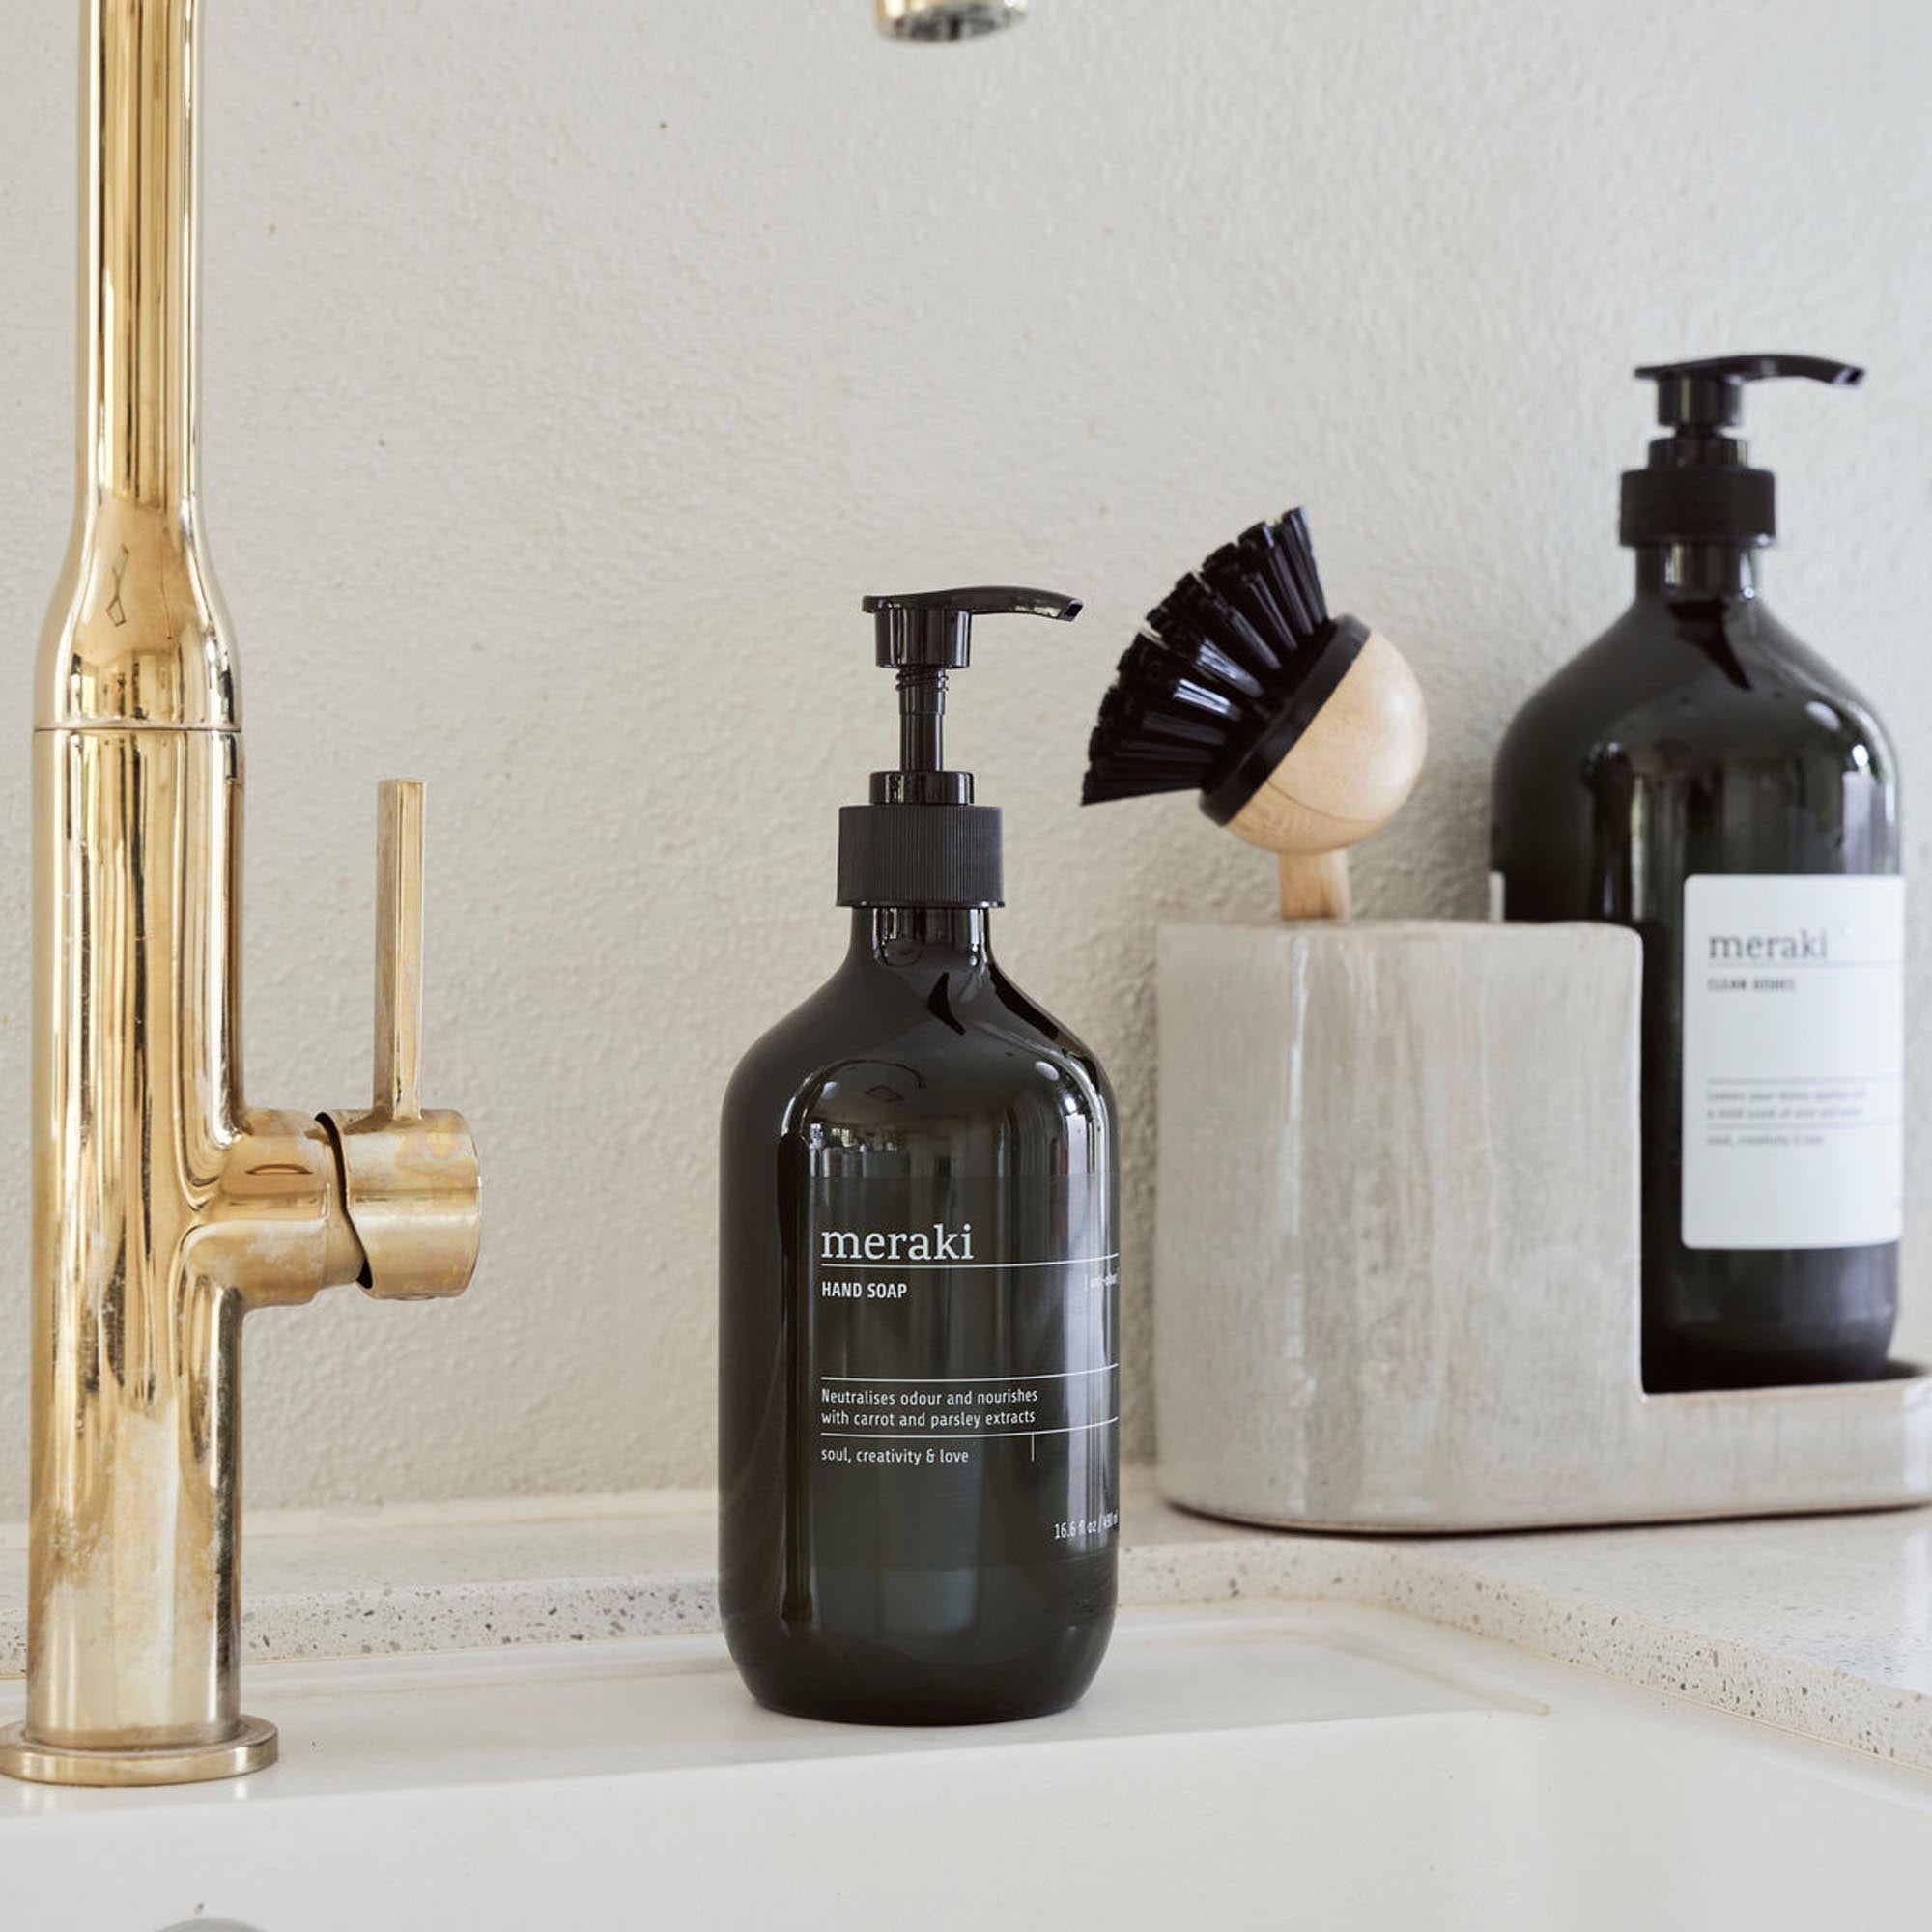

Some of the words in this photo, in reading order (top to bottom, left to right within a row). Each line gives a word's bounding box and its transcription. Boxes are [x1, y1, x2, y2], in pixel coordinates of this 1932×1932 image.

[1707, 928, 1828, 959] meraki
[820, 1223, 975, 1261] meraki
[821, 1281, 863, 1298] HAND
[867, 1283, 908, 1299] SOAP
[821, 1389, 896, 1405] Neutralises
[900, 1391, 942, 1406] odour
[947, 1390, 973, 1405] and
[978, 1389, 1038, 1404] nourishes
[821, 1411, 850, 1426] with
[854, 1413, 895, 1427] carrot
[899, 1412, 925, 1427] and
[930, 1411, 981, 1429] parsley
[985, 1410, 1036, 1425] extracts
[821, 1448, 852, 1463] soul,
[856, 1449, 922, 1466] creativity
[926, 1449, 935, 1463] &
[939, 1449, 969, 1463] love
[1054, 1520, 1077, 1540] 16.6
